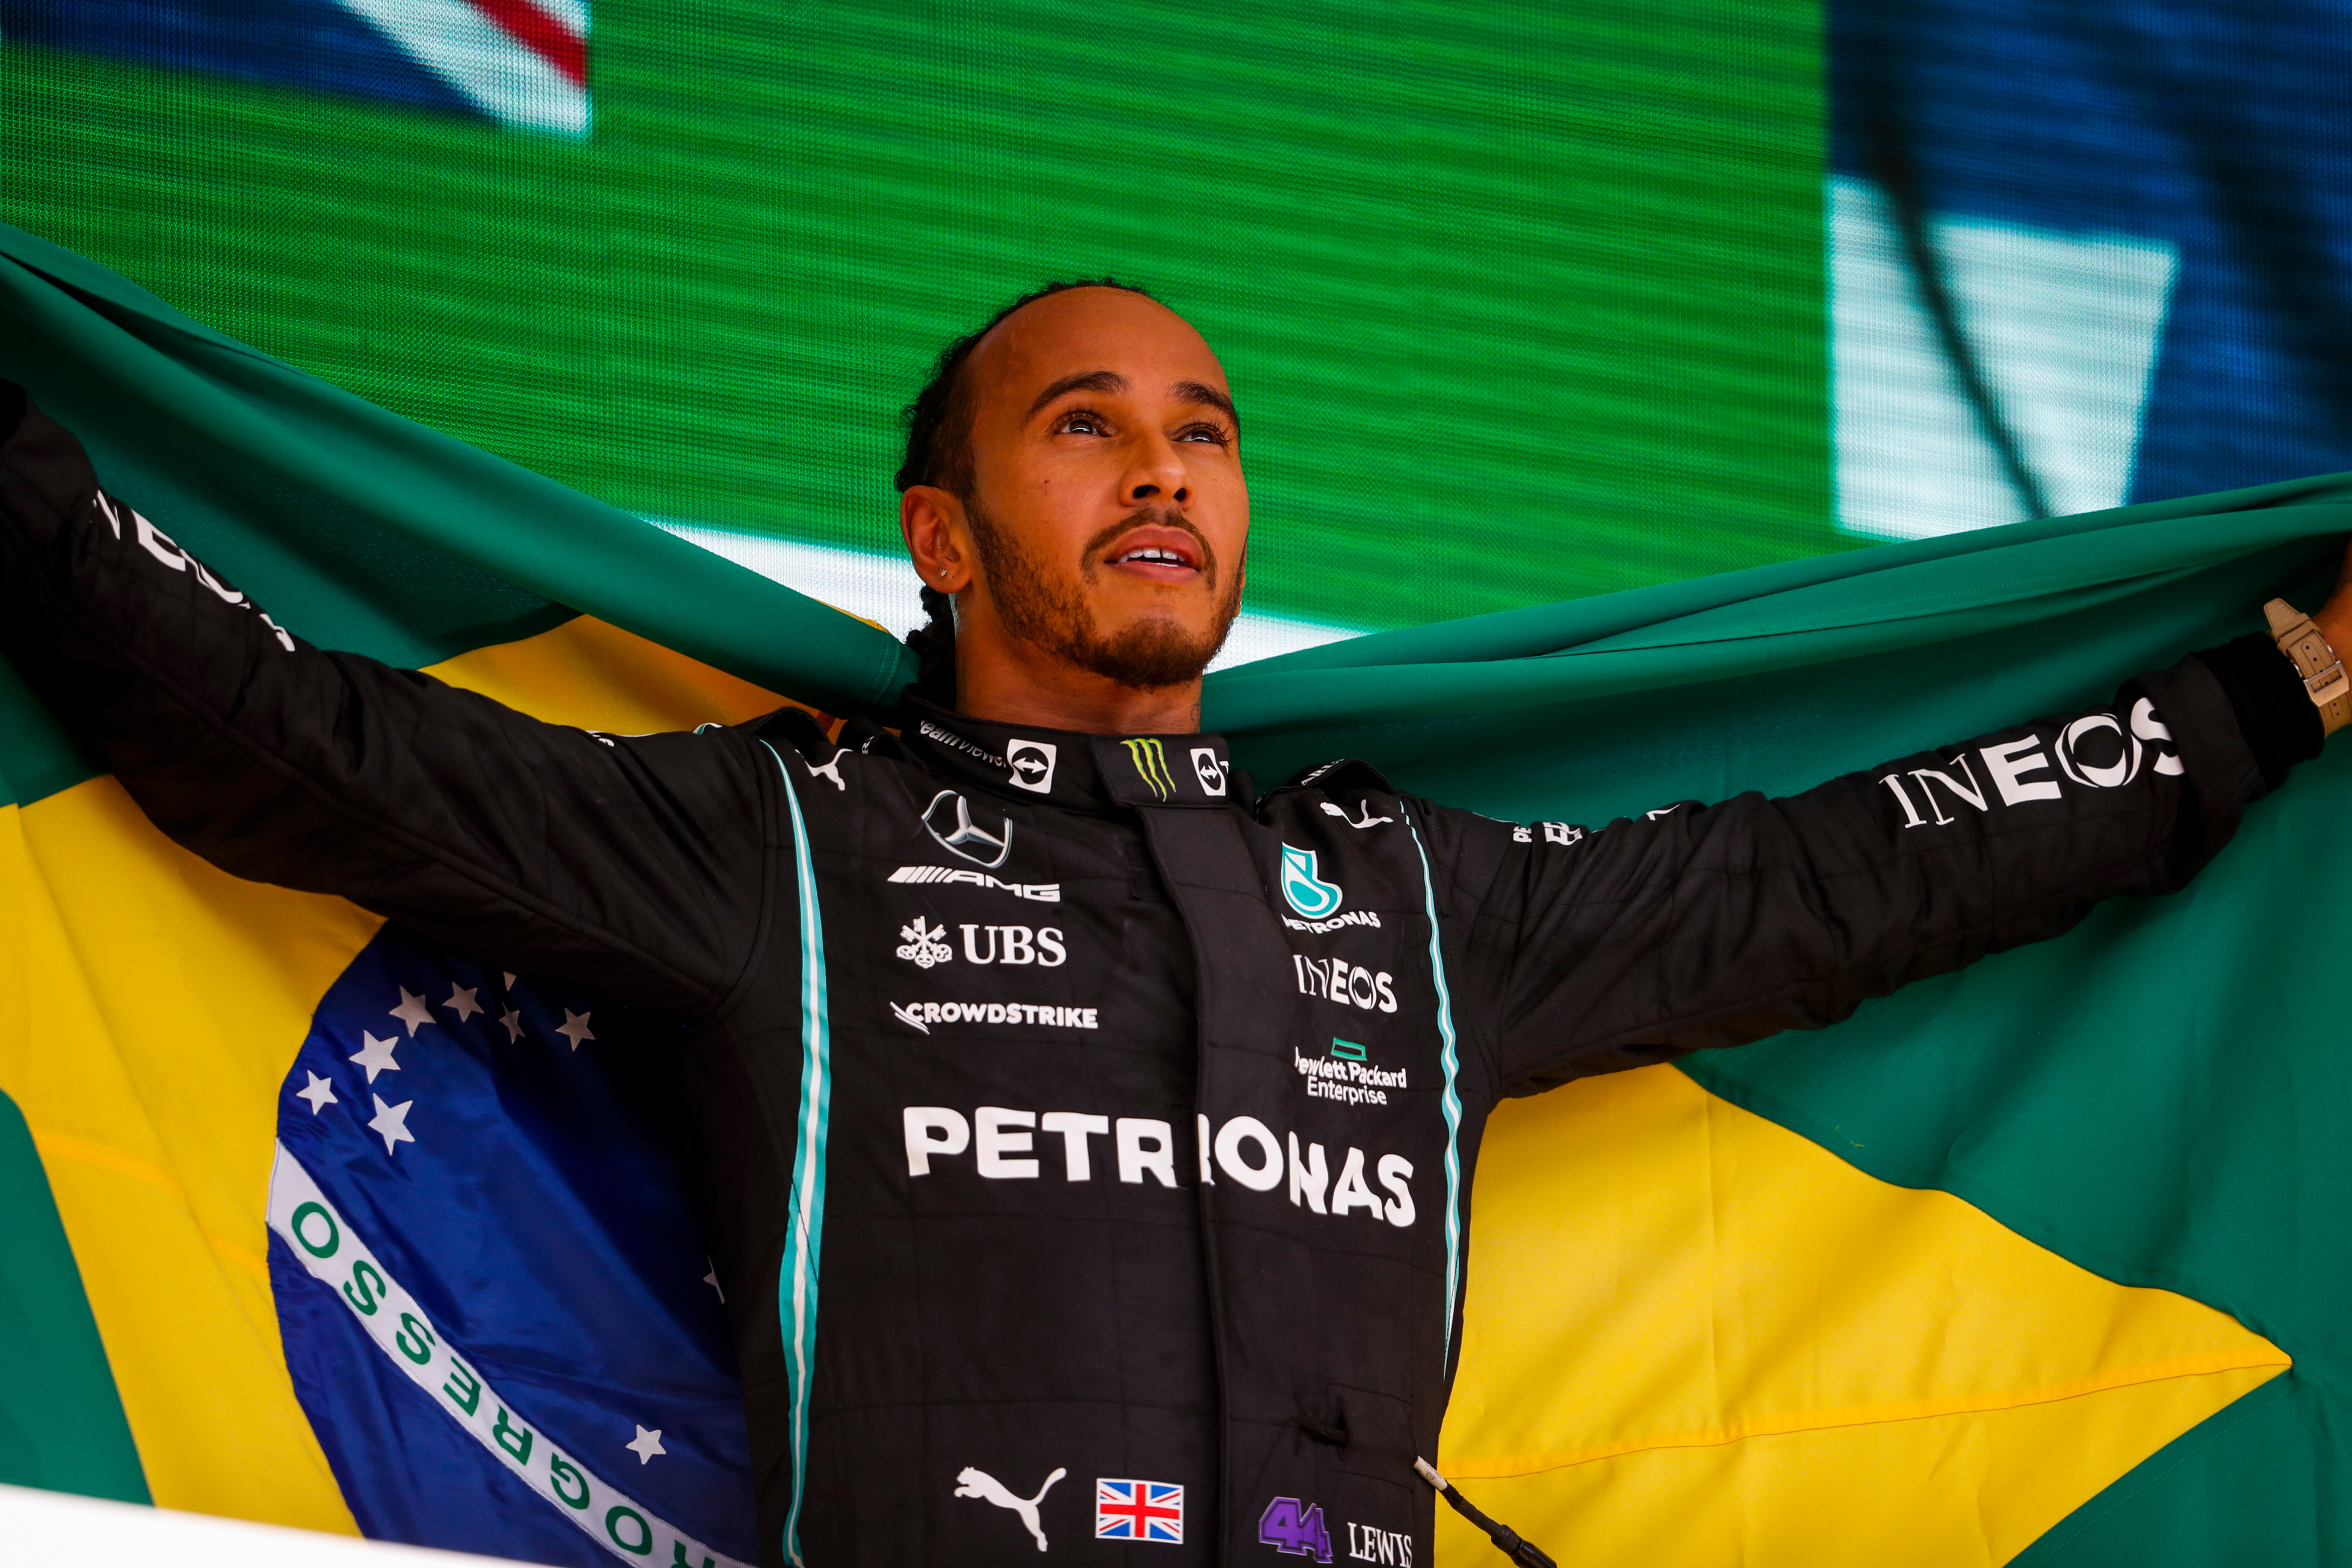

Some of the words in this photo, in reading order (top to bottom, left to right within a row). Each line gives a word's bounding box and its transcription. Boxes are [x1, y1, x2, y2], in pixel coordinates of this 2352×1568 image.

[1879, 698, 2185, 828] INEOS
[942, 869, 1060, 902] AMG
[958, 924, 1067, 967] UBS
[1293, 954, 1397, 1013] INEOS
[905, 1002, 1099, 1029] CROWDSTRIKE
[1307, 1075, 1387, 1106] Enterprise
[1348, 1061, 1407, 1089] Packard
[903, 1106, 1416, 1227] PETRONAS
[1258, 1496, 1333, 1564] 44
[1347, 1521, 1413, 1568] LEWIS
